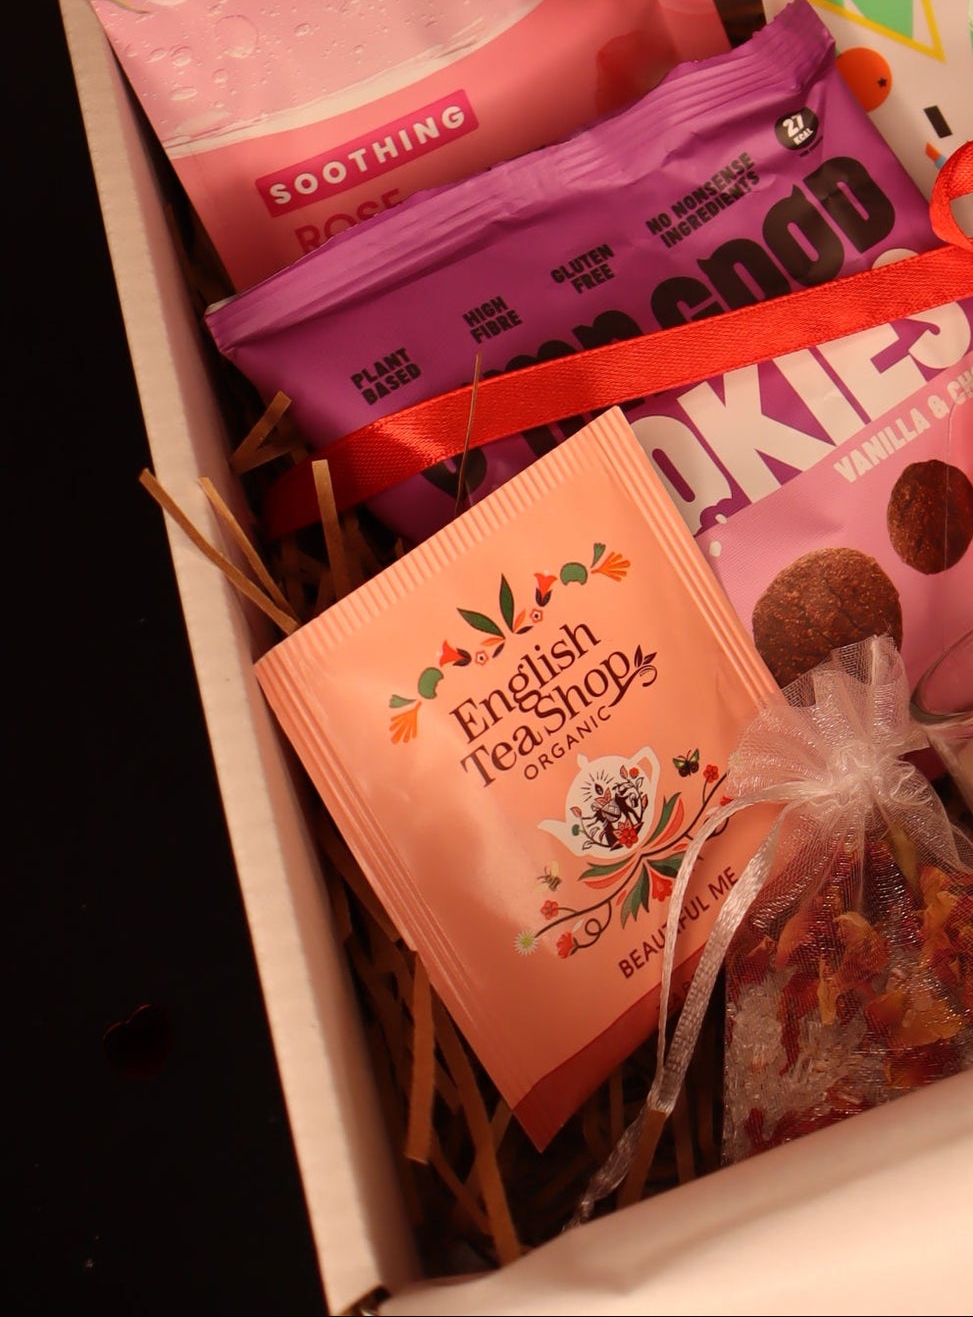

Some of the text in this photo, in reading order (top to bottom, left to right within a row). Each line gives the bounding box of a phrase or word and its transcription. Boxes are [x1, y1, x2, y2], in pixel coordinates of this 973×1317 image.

[269, 104, 466, 205] SOOTHING
[782, 114, 805, 138] 27
[645, 152, 755, 235] NO NONSENSE
[659, 170, 760, 249] INGREDIENTS
[550, 243, 615, 283] GLUTEN
[570, 263, 615, 294] FREE
[462, 295, 508, 328] HIGH
[470, 309, 523, 344] FIBRE
[350, 347, 410, 390] PLANT
[361, 363, 421, 406] BASED
[833, 409, 931, 483] VANILLA
[927, 391, 950, 419] &
[450, 619, 602, 744] English
[460, 648, 652, 788] Tea Shop
[523, 705, 611, 781] ORGANIC
[618, 866, 738, 979] BEAUFUL ME
